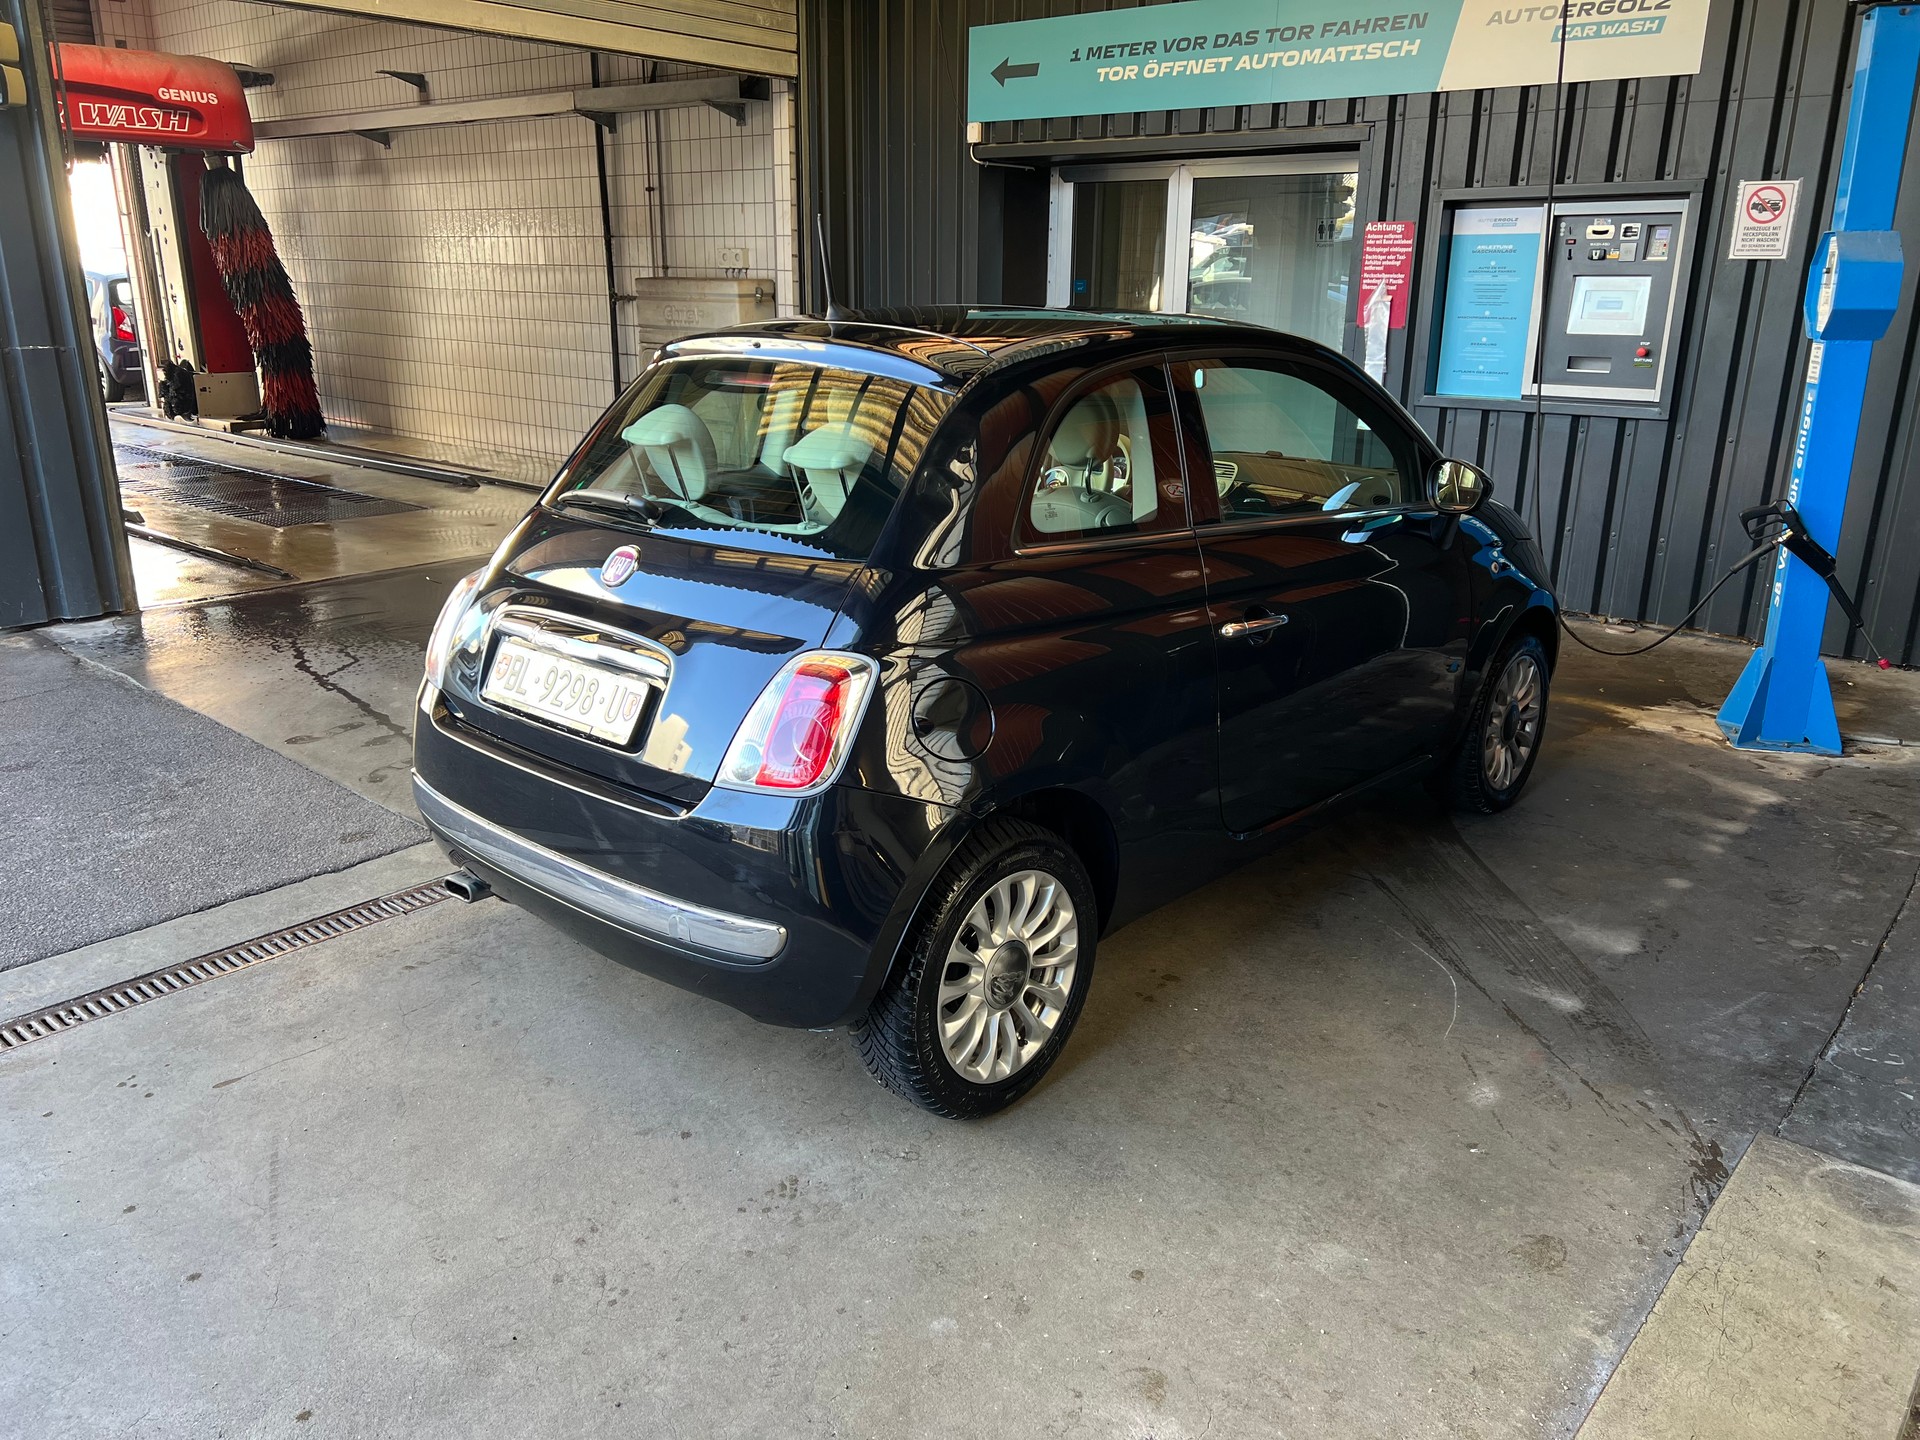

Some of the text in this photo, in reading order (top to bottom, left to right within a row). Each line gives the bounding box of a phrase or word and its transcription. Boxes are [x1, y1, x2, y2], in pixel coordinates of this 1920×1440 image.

[1486, 0, 1671, 26] AUTOERGOLZ
[1070, 12, 1429, 63] 1 METER VOR DAS TOR FAHREN
[1557, 20, 1660, 39] CAR WASH
[1097, 39, 1421, 83] TOR ÖFFNET AUTOMATISCH
[157, 87, 218, 105] GENIUS
[78, 102, 190, 132] WASH
[1366, 222, 1405, 233] Achtung:
[605, 555, 632, 578] FIAT
